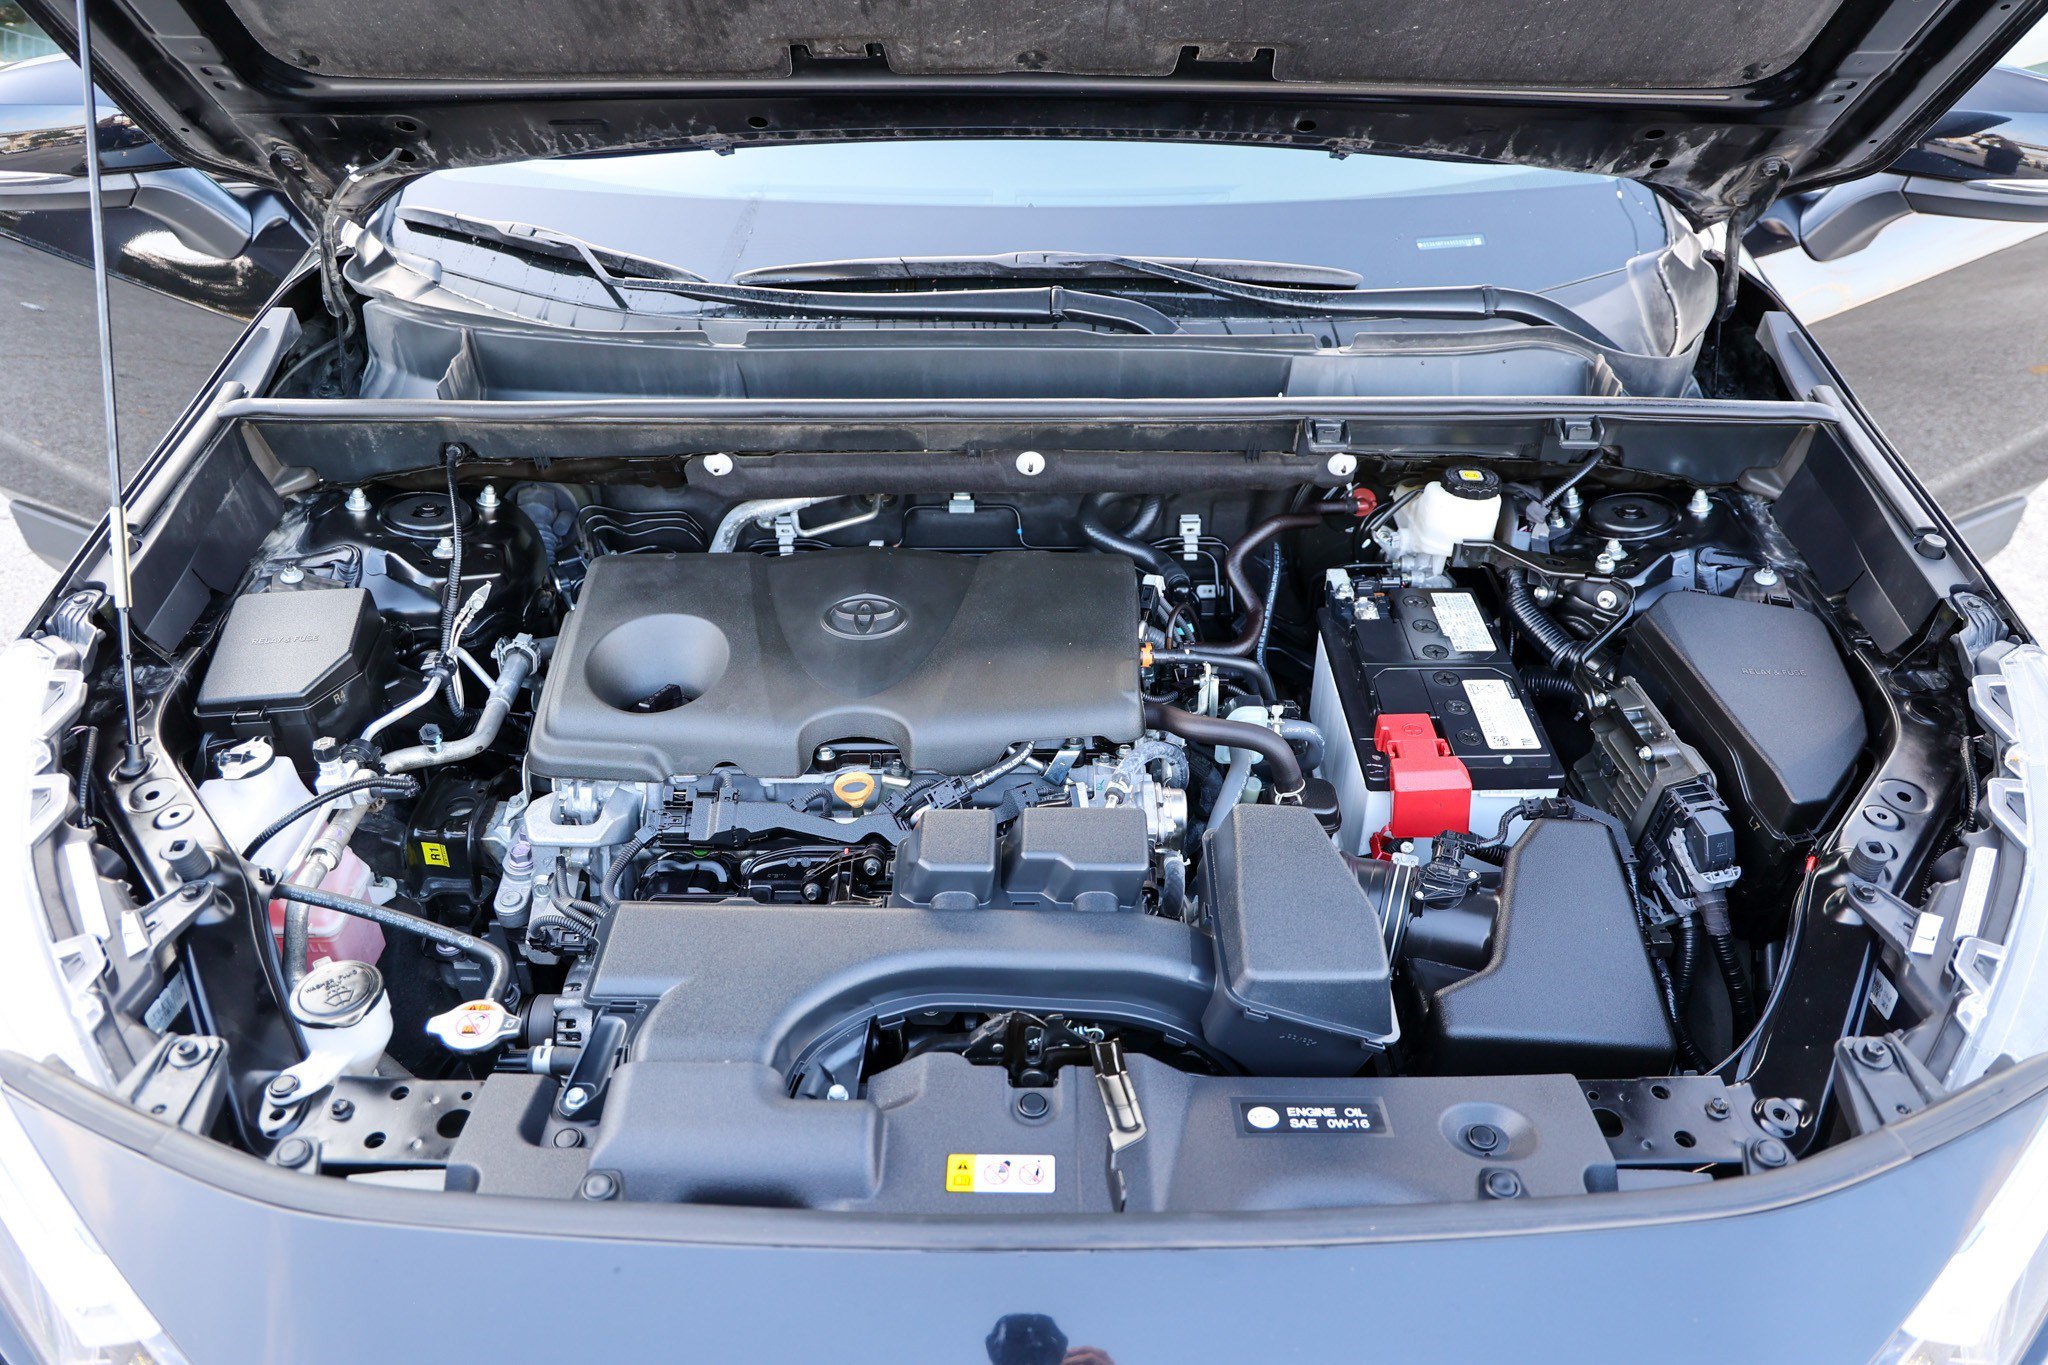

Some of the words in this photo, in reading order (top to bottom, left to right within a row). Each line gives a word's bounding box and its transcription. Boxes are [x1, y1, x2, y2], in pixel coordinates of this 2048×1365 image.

[251, 636, 284, 645] RELAY
[293, 634, 320, 643] FUSE
[1741, 667, 1771, 676] RELAY
[1781, 669, 1807, 677] FUSE
[332, 690, 346, 705] R4
[429, 848, 441, 861] R1
[305, 978, 335, 994] WASHER
[338, 969, 358, 980] FLUID
[1286, 1107, 1337, 1118] ENGINE
[1344, 1107, 1368, 1118] OIL
[1289, 1118, 1319, 1129] SAE
[1327, 1118, 1371, 1129] 0W-16
